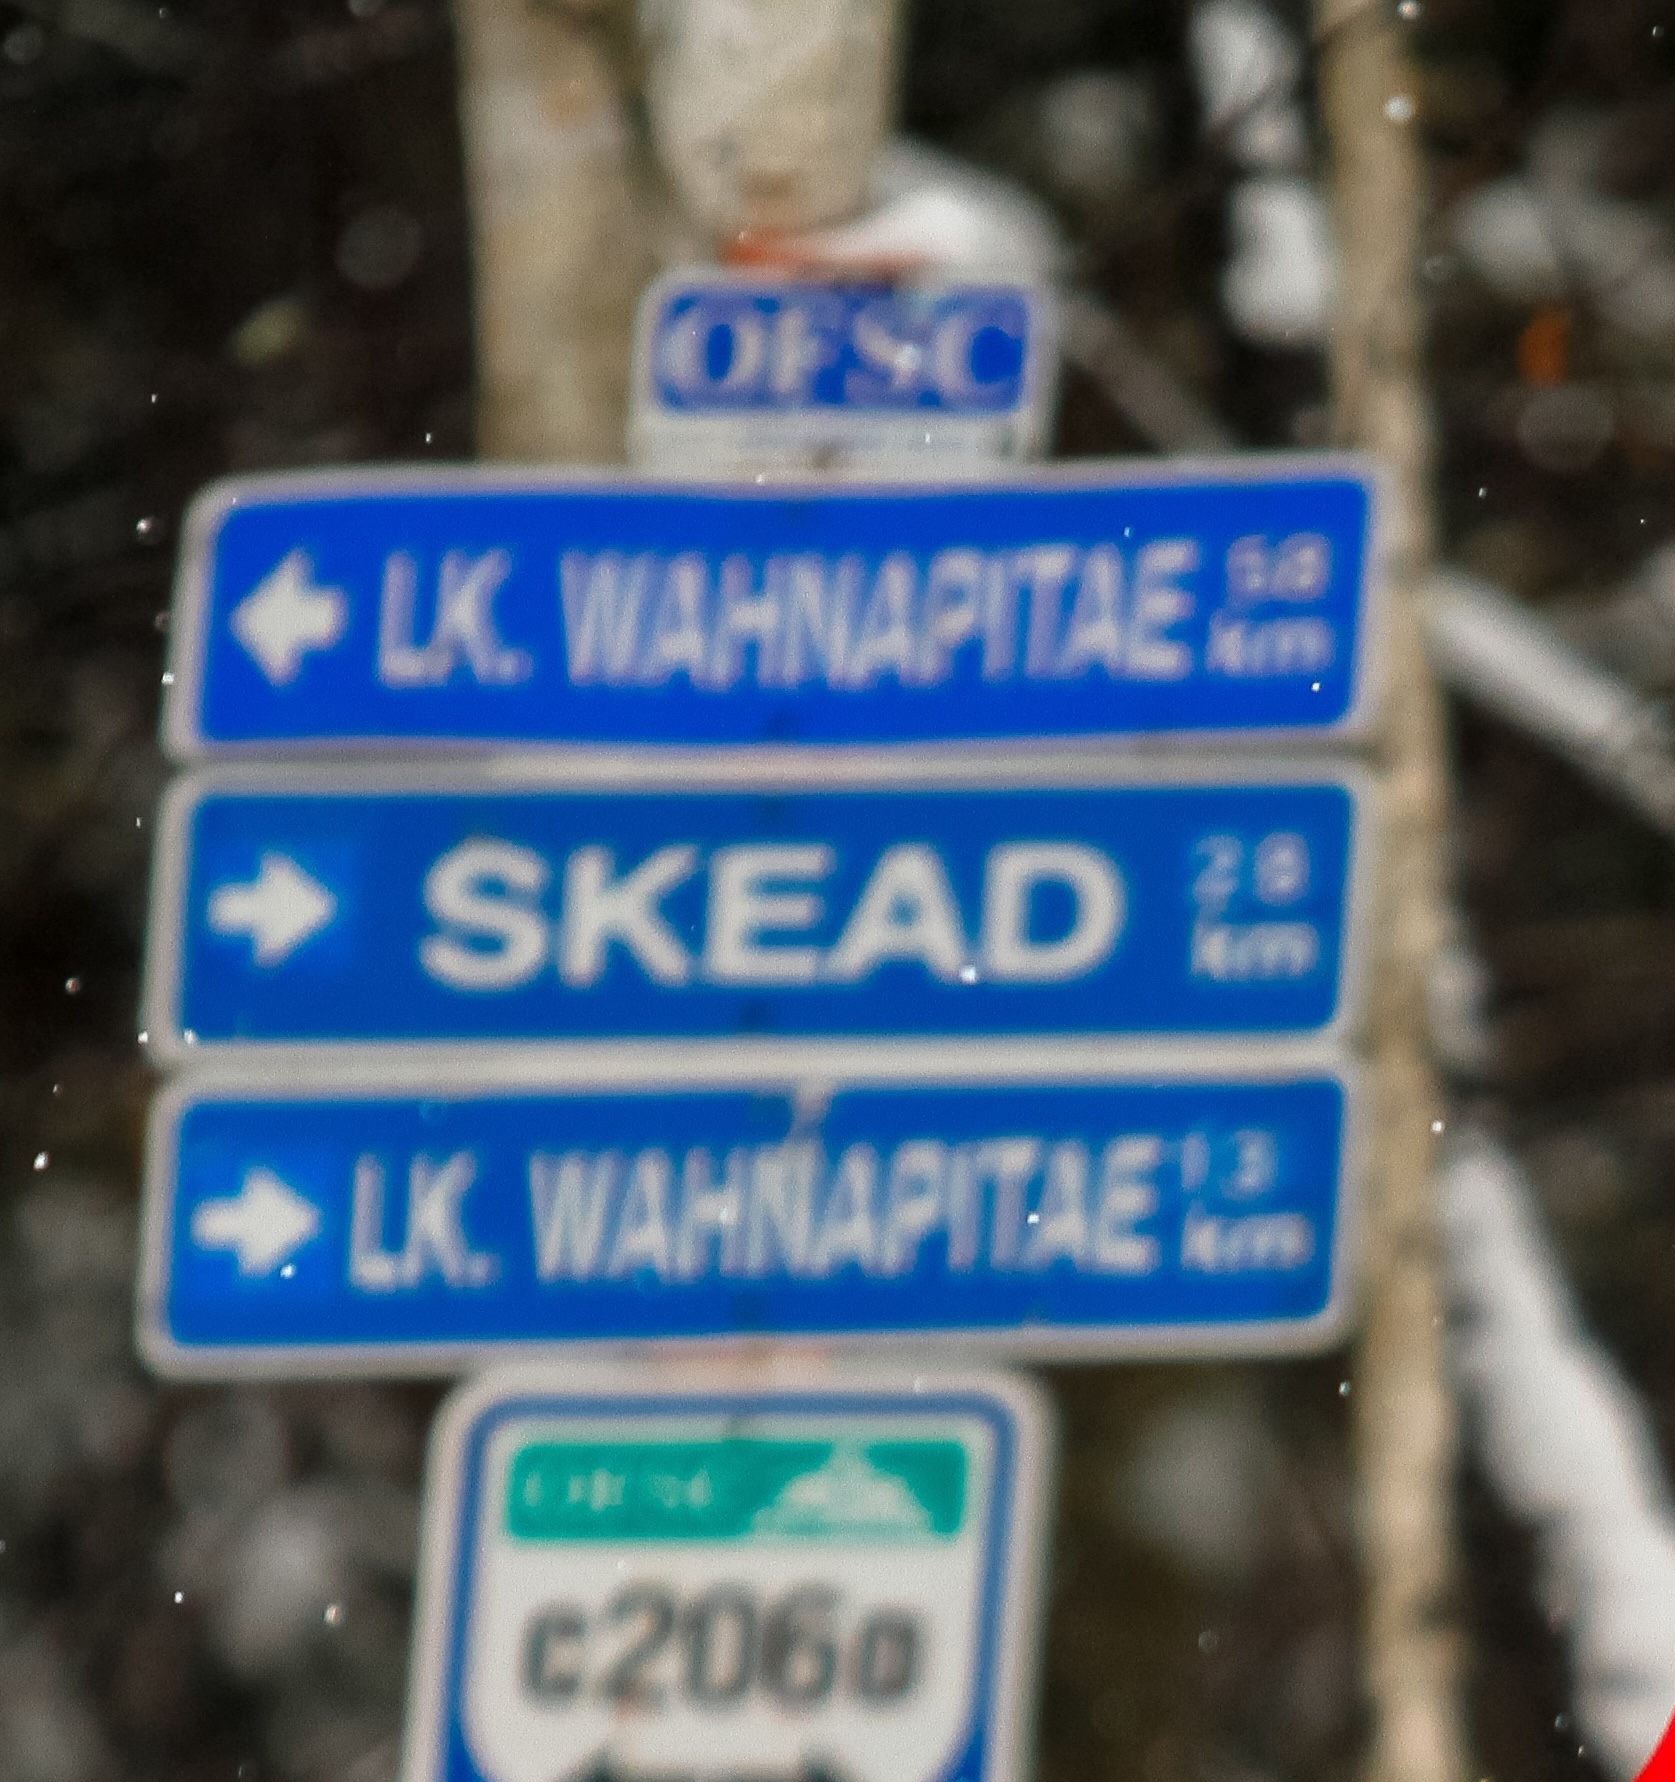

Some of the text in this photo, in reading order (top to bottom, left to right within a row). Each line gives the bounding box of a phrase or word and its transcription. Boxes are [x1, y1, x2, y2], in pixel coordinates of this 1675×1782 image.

[660, 292, 1026, 402] OFSC
[377, 548, 533, 684] LK.
[560, 538, 1198, 686] WAHNAPITAE
[420, 840, 1128, 990] SKEAD
[348, 1152, 500, 1290] LK.
[530, 1133, 1160, 1280] WAHNAPITAE
